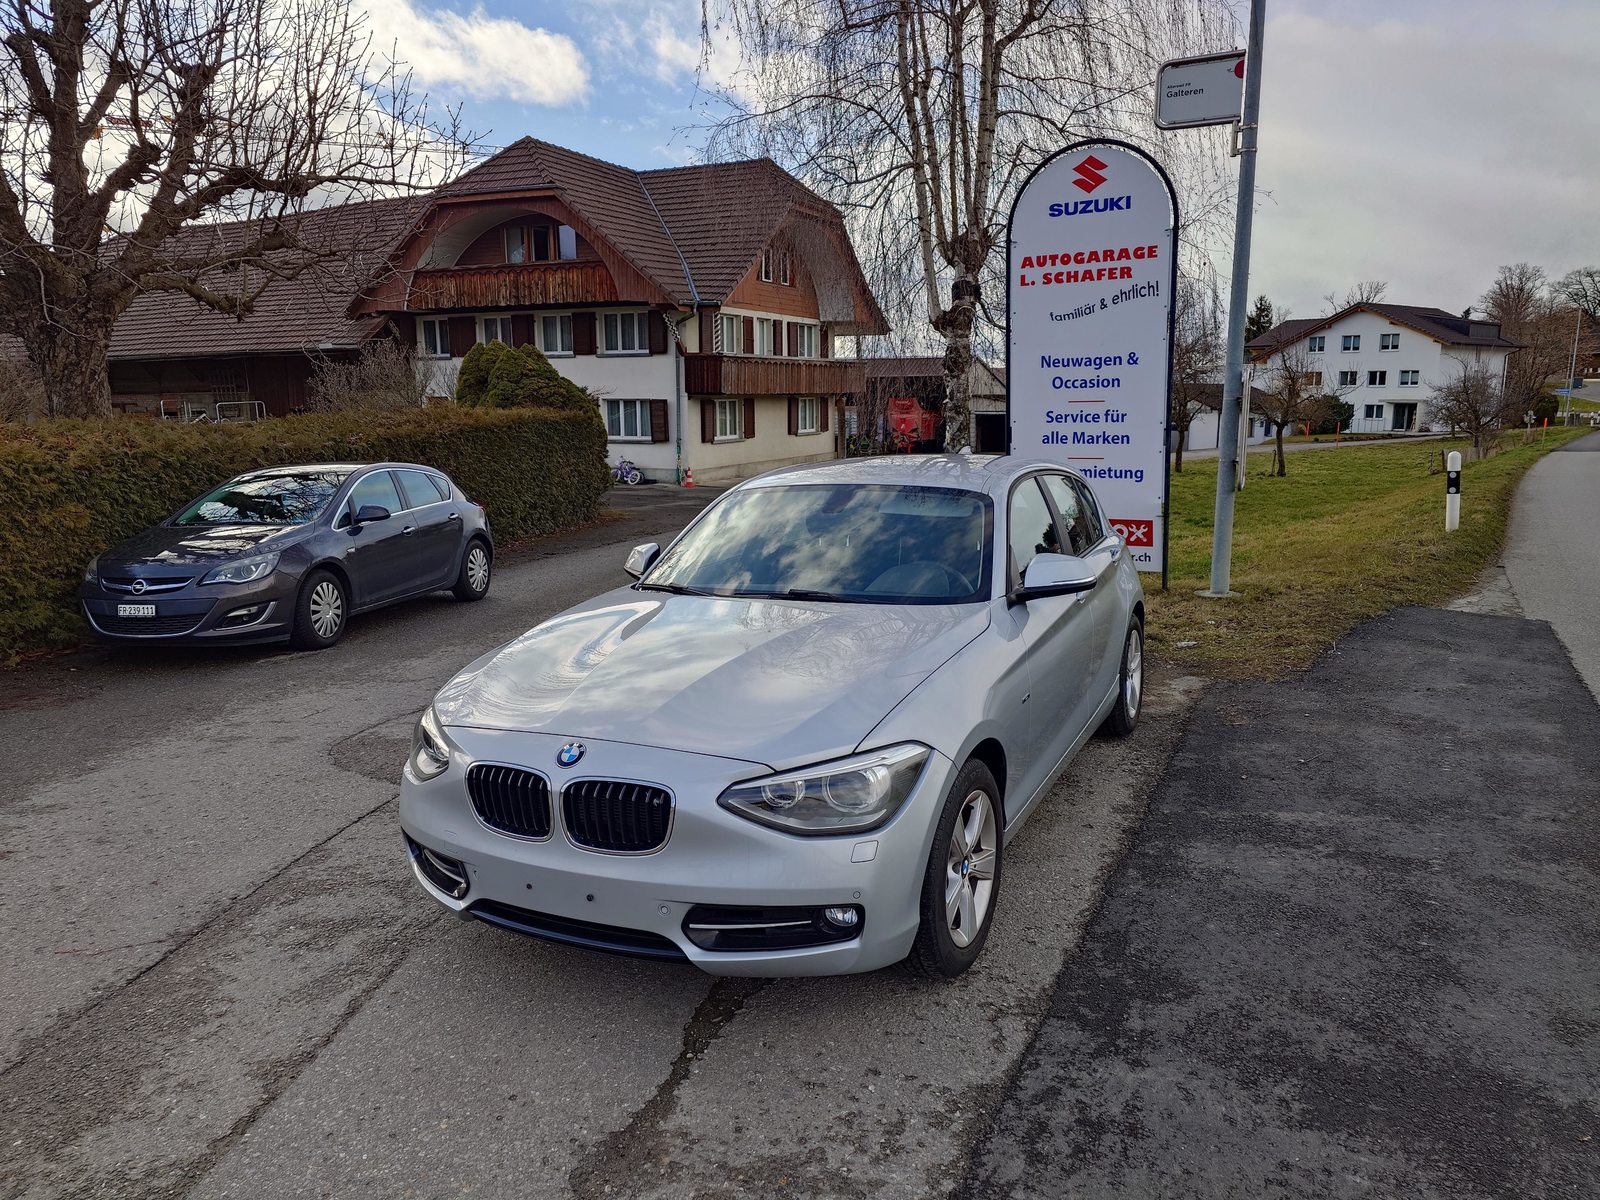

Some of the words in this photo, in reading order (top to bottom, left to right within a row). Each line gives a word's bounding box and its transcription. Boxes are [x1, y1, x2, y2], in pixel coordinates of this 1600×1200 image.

[1166, 88, 1204, 98] Galteren
[1049, 195, 1131, 217] SUZUKI
[1021, 245, 1158, 269] AUTOGARAGE
[1020, 274, 1036, 287] L.
[1050, 303, 1096, 322] familiär
[1100, 298, 1108, 310] &
[1112, 280, 1160, 305] ehrlich!
[1041, 355, 1123, 370] Neuwagen
[1127, 351, 1139, 366] &
[1052, 374, 1121, 390] Occasion
[1046, 409, 1101, 424] Service
[1104, 408, 1127, 423] für
[1042, 430, 1069, 445] alle
[1072, 430, 1130, 445] Marken
